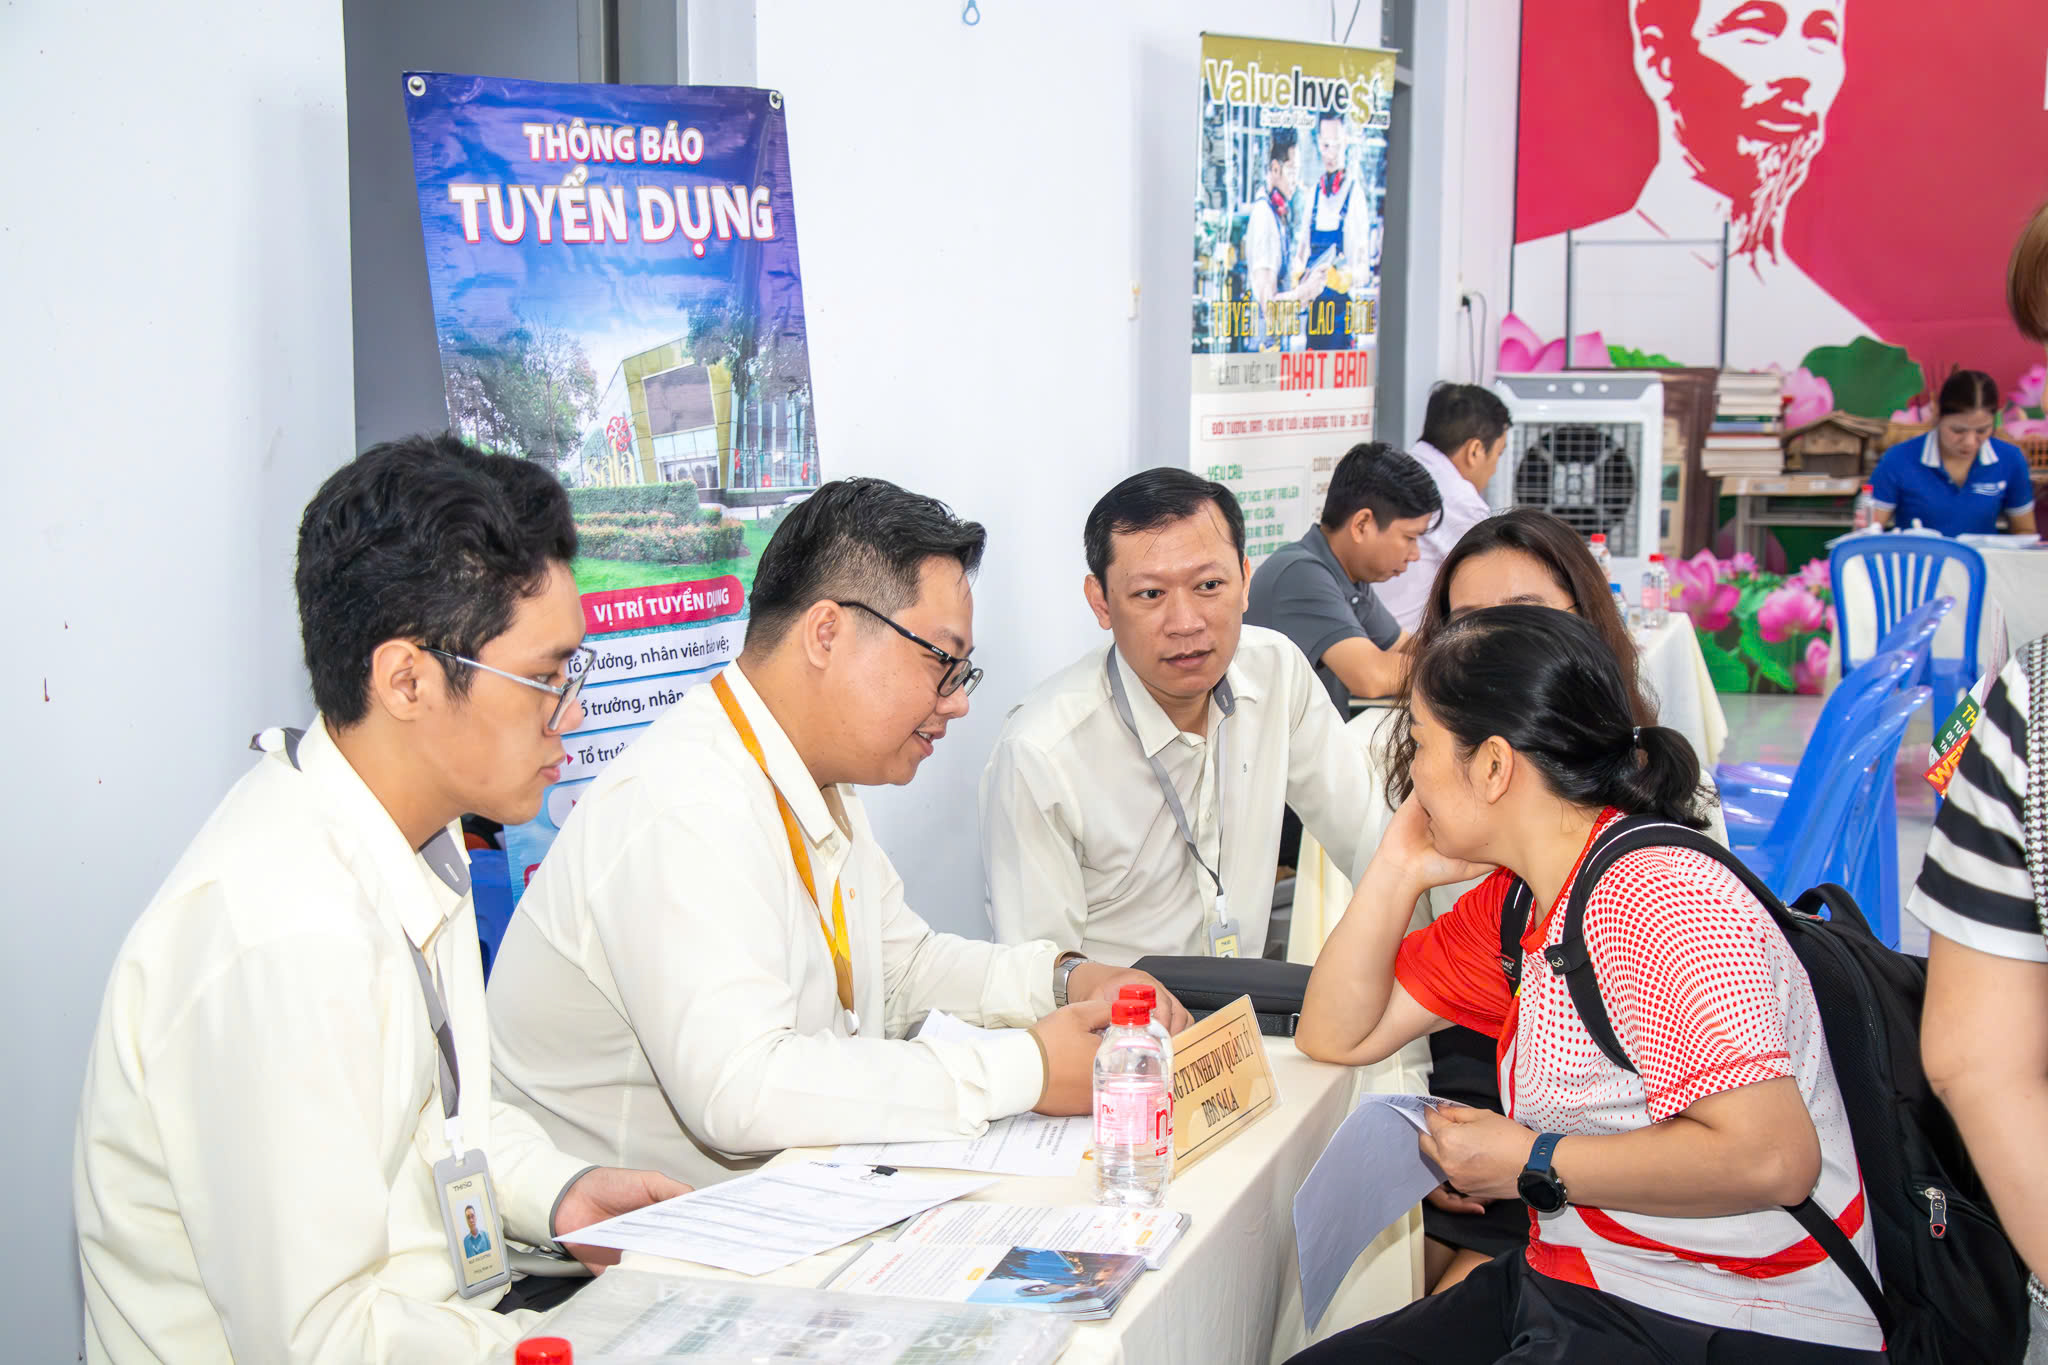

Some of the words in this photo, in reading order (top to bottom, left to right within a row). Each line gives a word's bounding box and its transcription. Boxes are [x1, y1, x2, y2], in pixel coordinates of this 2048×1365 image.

[523, 117, 637, 163] THÔNG
[640, 120, 704, 164] BÁO
[449, 164, 629, 244] TUYỂN
[637, 184, 775, 258] DỤNG
[1308, 300, 1336, 335] LAO
[1280, 348, 1328, 397] NHẬT
[593, 603, 614, 626] VỊ
[616, 598, 644, 620] TRÍ
[646, 589, 705, 617] TUYỂN
[706, 588, 730, 611] DỤNG
[641, 645, 678, 663] nhân
[681, 643, 705, 657] viên
[591, 696, 645, 714] trưởng,
[578, 746, 595, 765] Tổ
[1190, 1051, 1216, 1089] TNHH
[1210, 1047, 1225, 1077] DV
[1221, 1031, 1243, 1075] QUẢN
[1217, 1085, 1240, 1119] SALA
